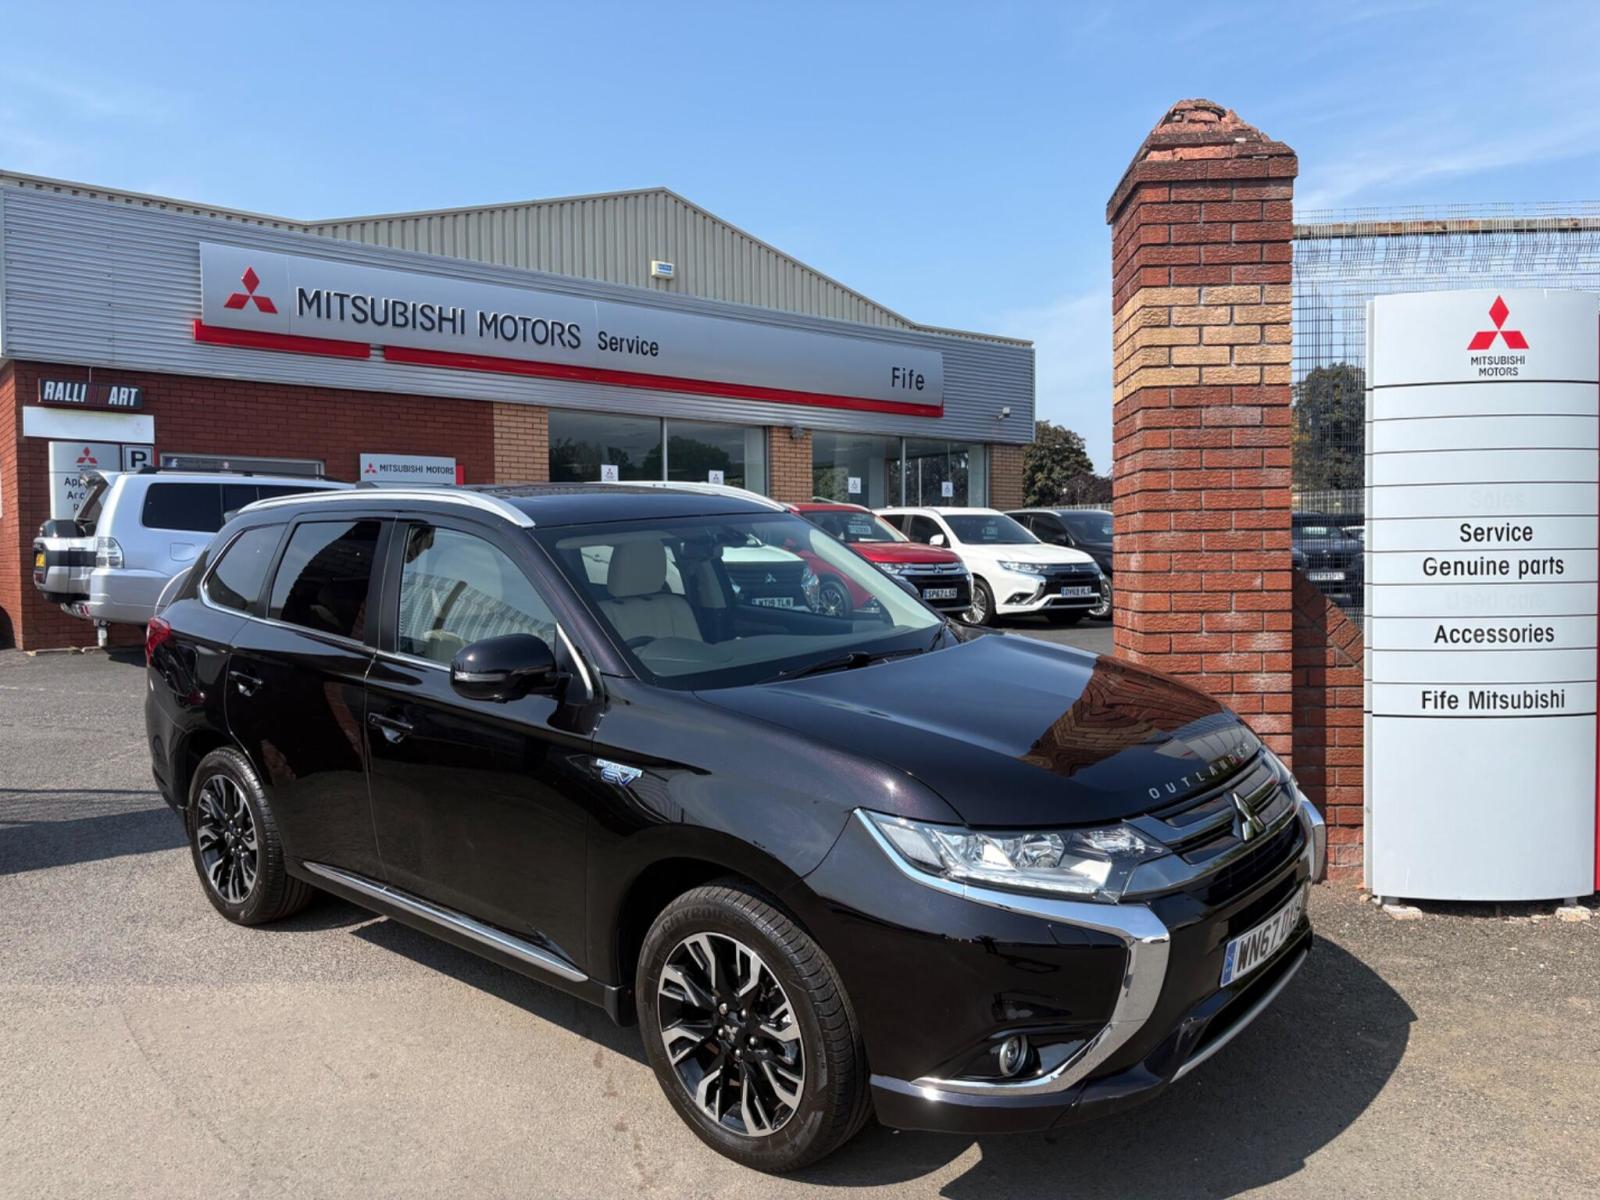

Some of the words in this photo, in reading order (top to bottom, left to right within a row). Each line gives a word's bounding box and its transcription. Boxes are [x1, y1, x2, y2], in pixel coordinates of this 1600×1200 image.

[296, 286, 466, 335] MITSUBISHI
[477, 310, 582, 350] MOTORS
[597, 331, 659, 357] Service
[1470, 355, 1526, 366] MITSUBISHI
[1478, 366, 1519, 377] MOTORS
[891, 366, 925, 391] Fife
[43, 381, 87, 403] RALLI
[108, 386, 138, 406] ART
[130, 451, 148, 468] P
[379, 463, 424, 473] MITSUBISHI
[426, 465, 455, 475] MOTORS
[1460, 523, 1533, 543] Service
[1422, 556, 1510, 576] Genuine
[1518, 556, 1565, 580] parts
[1433, 623, 1555, 644] Accessories
[1421, 690, 1459, 710] Fife
[1468, 688, 1565, 710] Mitsubishi
[1148, 742, 1250, 800] OUTLANDER
[1236, 914, 1281, 973] WN67
